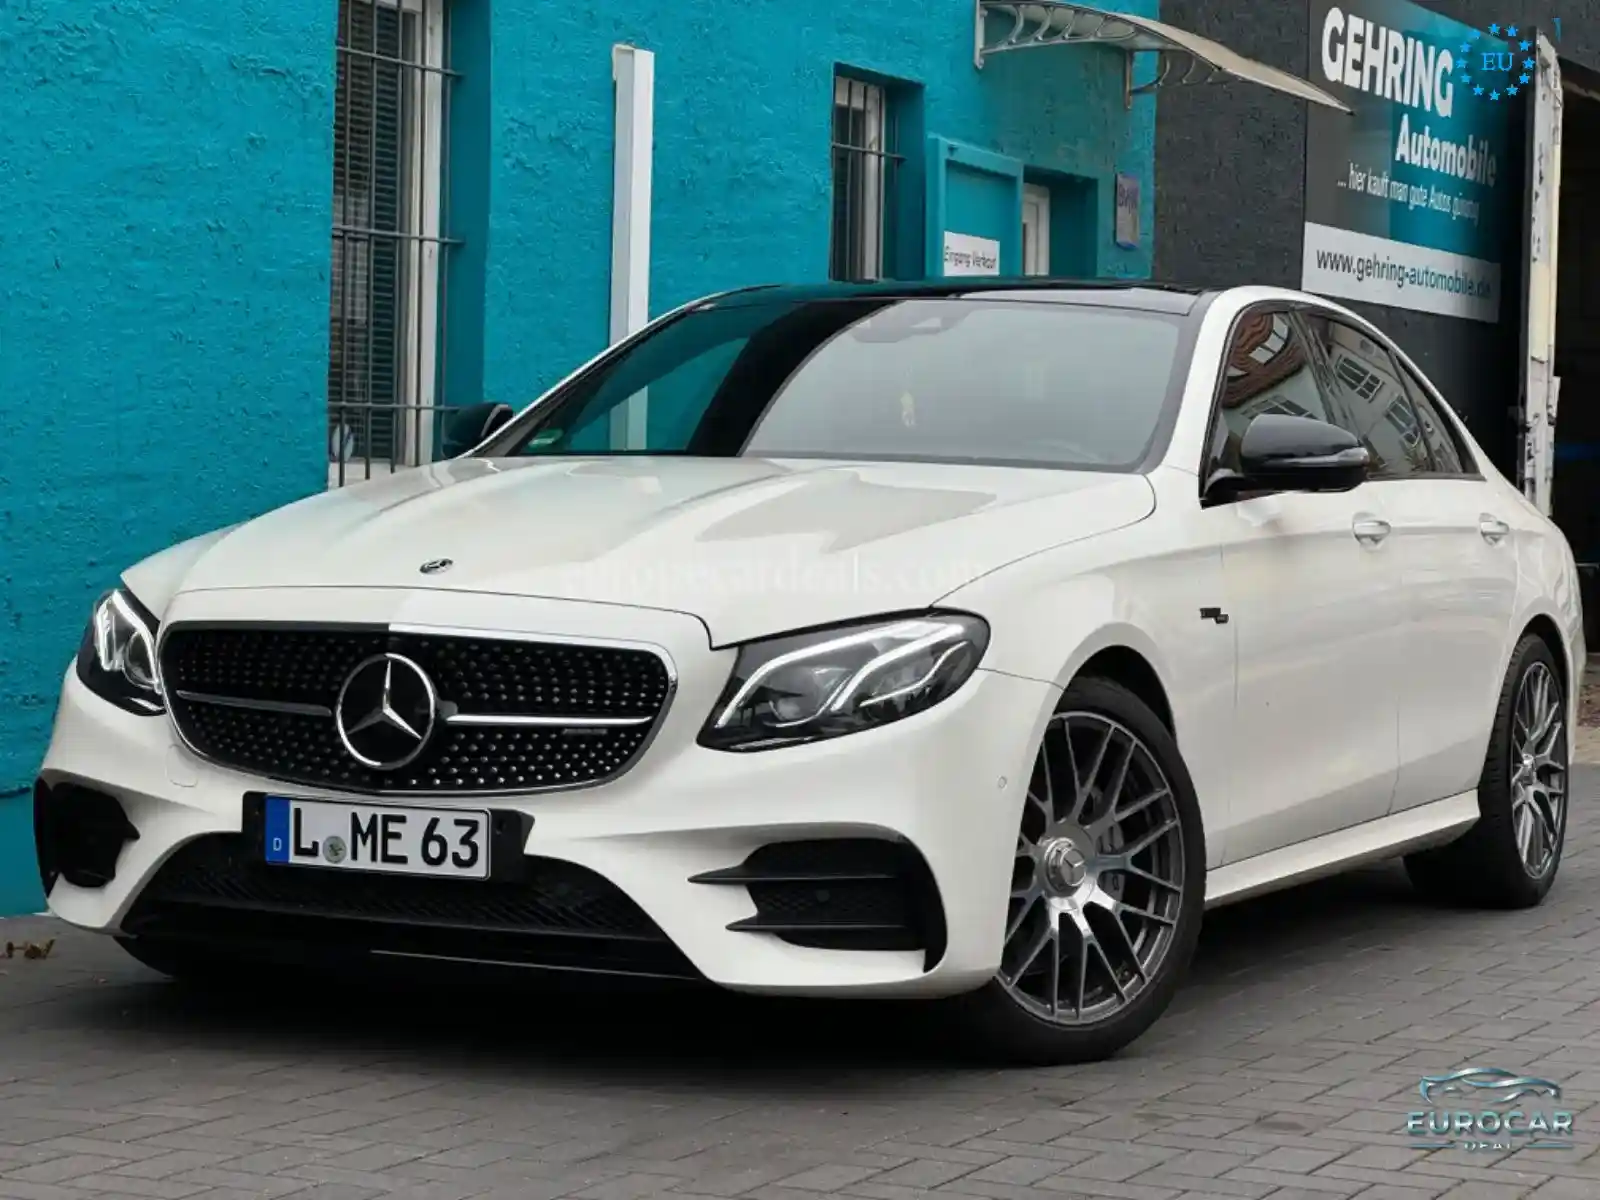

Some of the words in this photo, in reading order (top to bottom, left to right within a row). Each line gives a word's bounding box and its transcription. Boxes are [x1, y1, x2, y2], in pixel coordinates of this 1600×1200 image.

[1321, 7, 1453, 117] GEHRING
[1348, 161, 1367, 192] hier
[1389, 180, 1408, 202] man
[1395, 114, 1498, 186] Automobile
[273, 838, 282, 851] D
[294, 808, 319, 857] L
[351, 812, 408, 864] ME
[421, 817, 480, 868] 63
